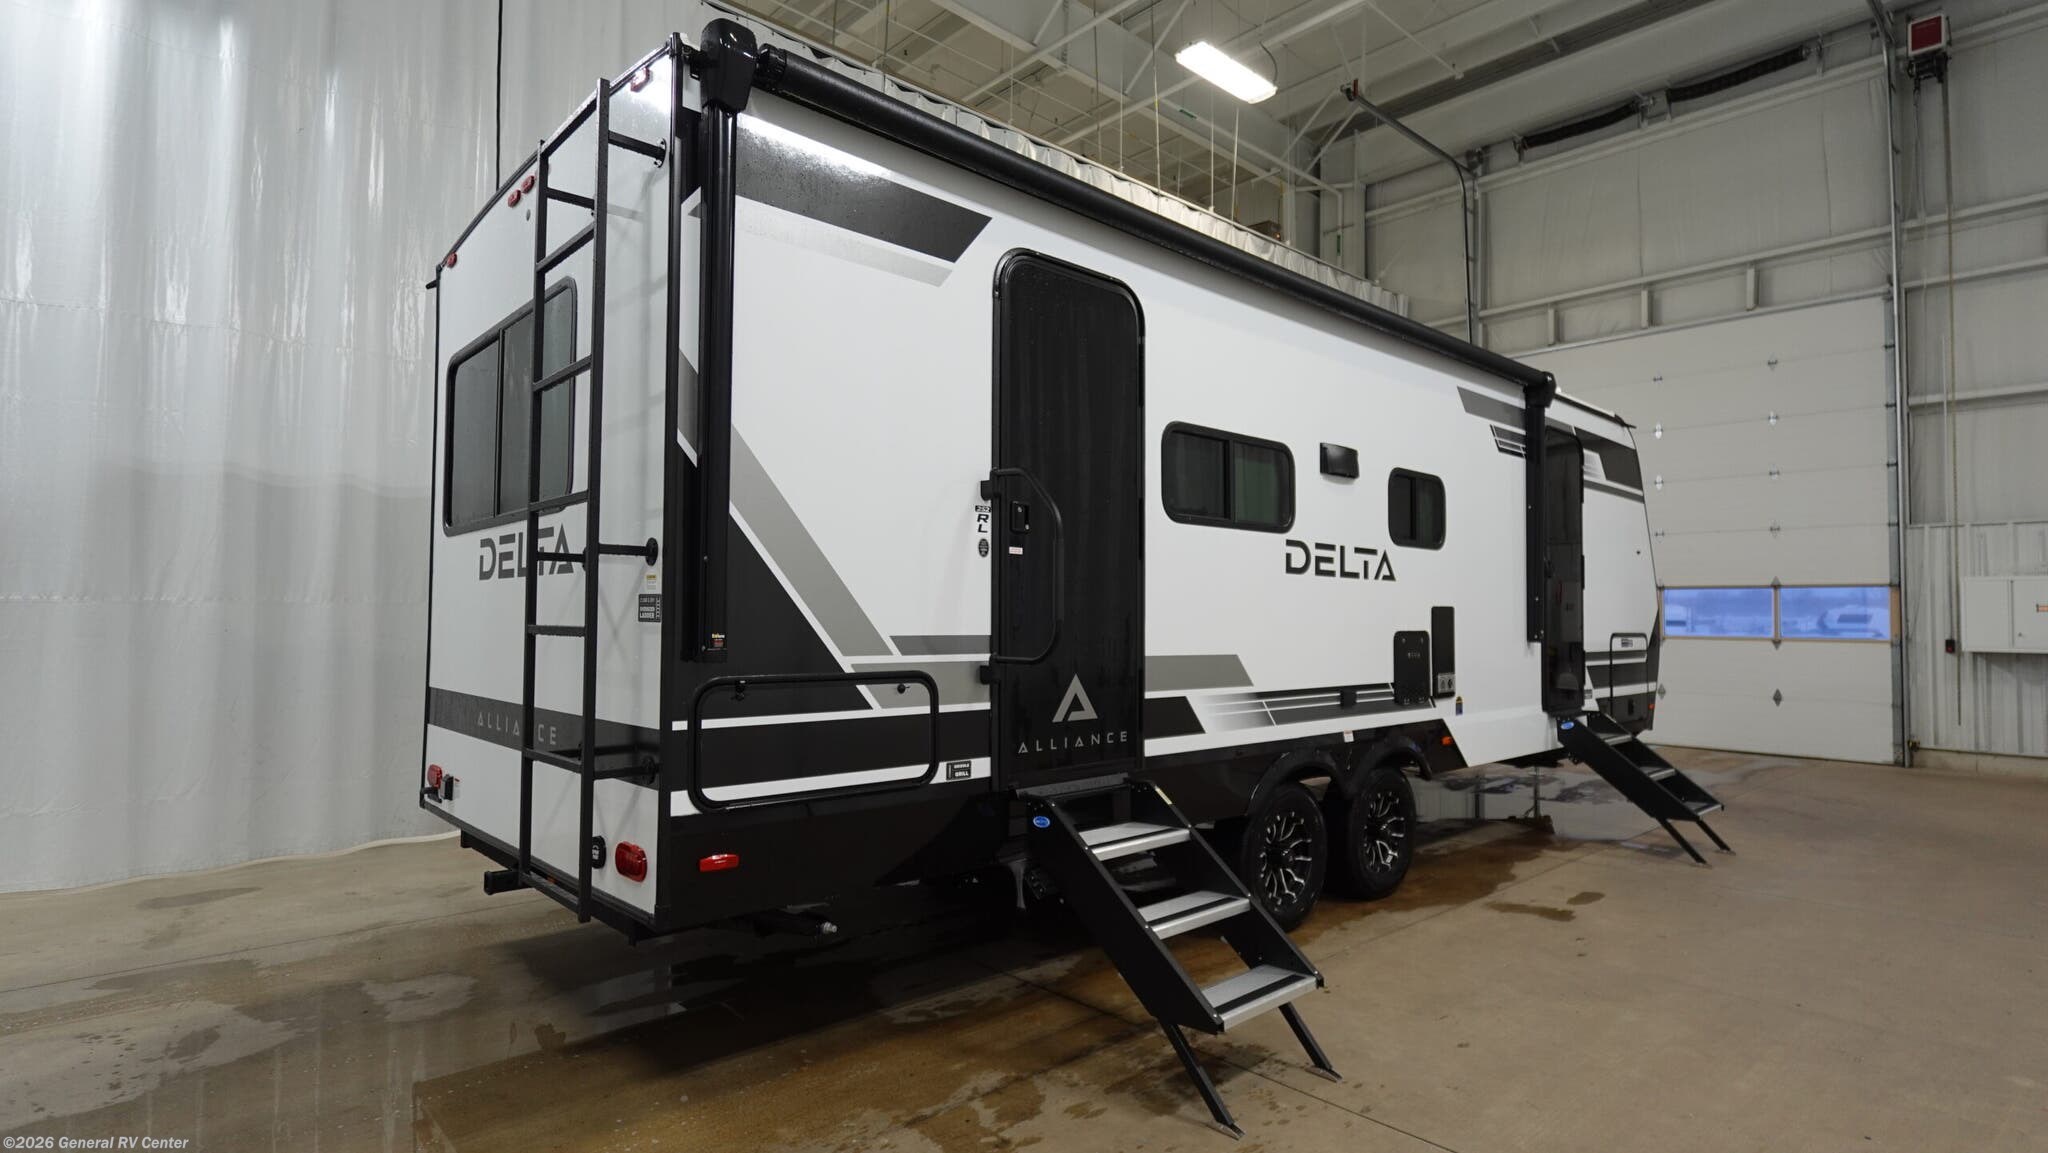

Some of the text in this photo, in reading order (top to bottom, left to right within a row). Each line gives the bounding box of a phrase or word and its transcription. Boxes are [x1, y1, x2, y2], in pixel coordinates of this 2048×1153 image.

[479, 523, 574, 580] DELTA
[1285, 539, 1396, 581] DELTA
[478, 712, 557, 745] ALLIACE
[1018, 731, 1127, 753] ALLIANCE
